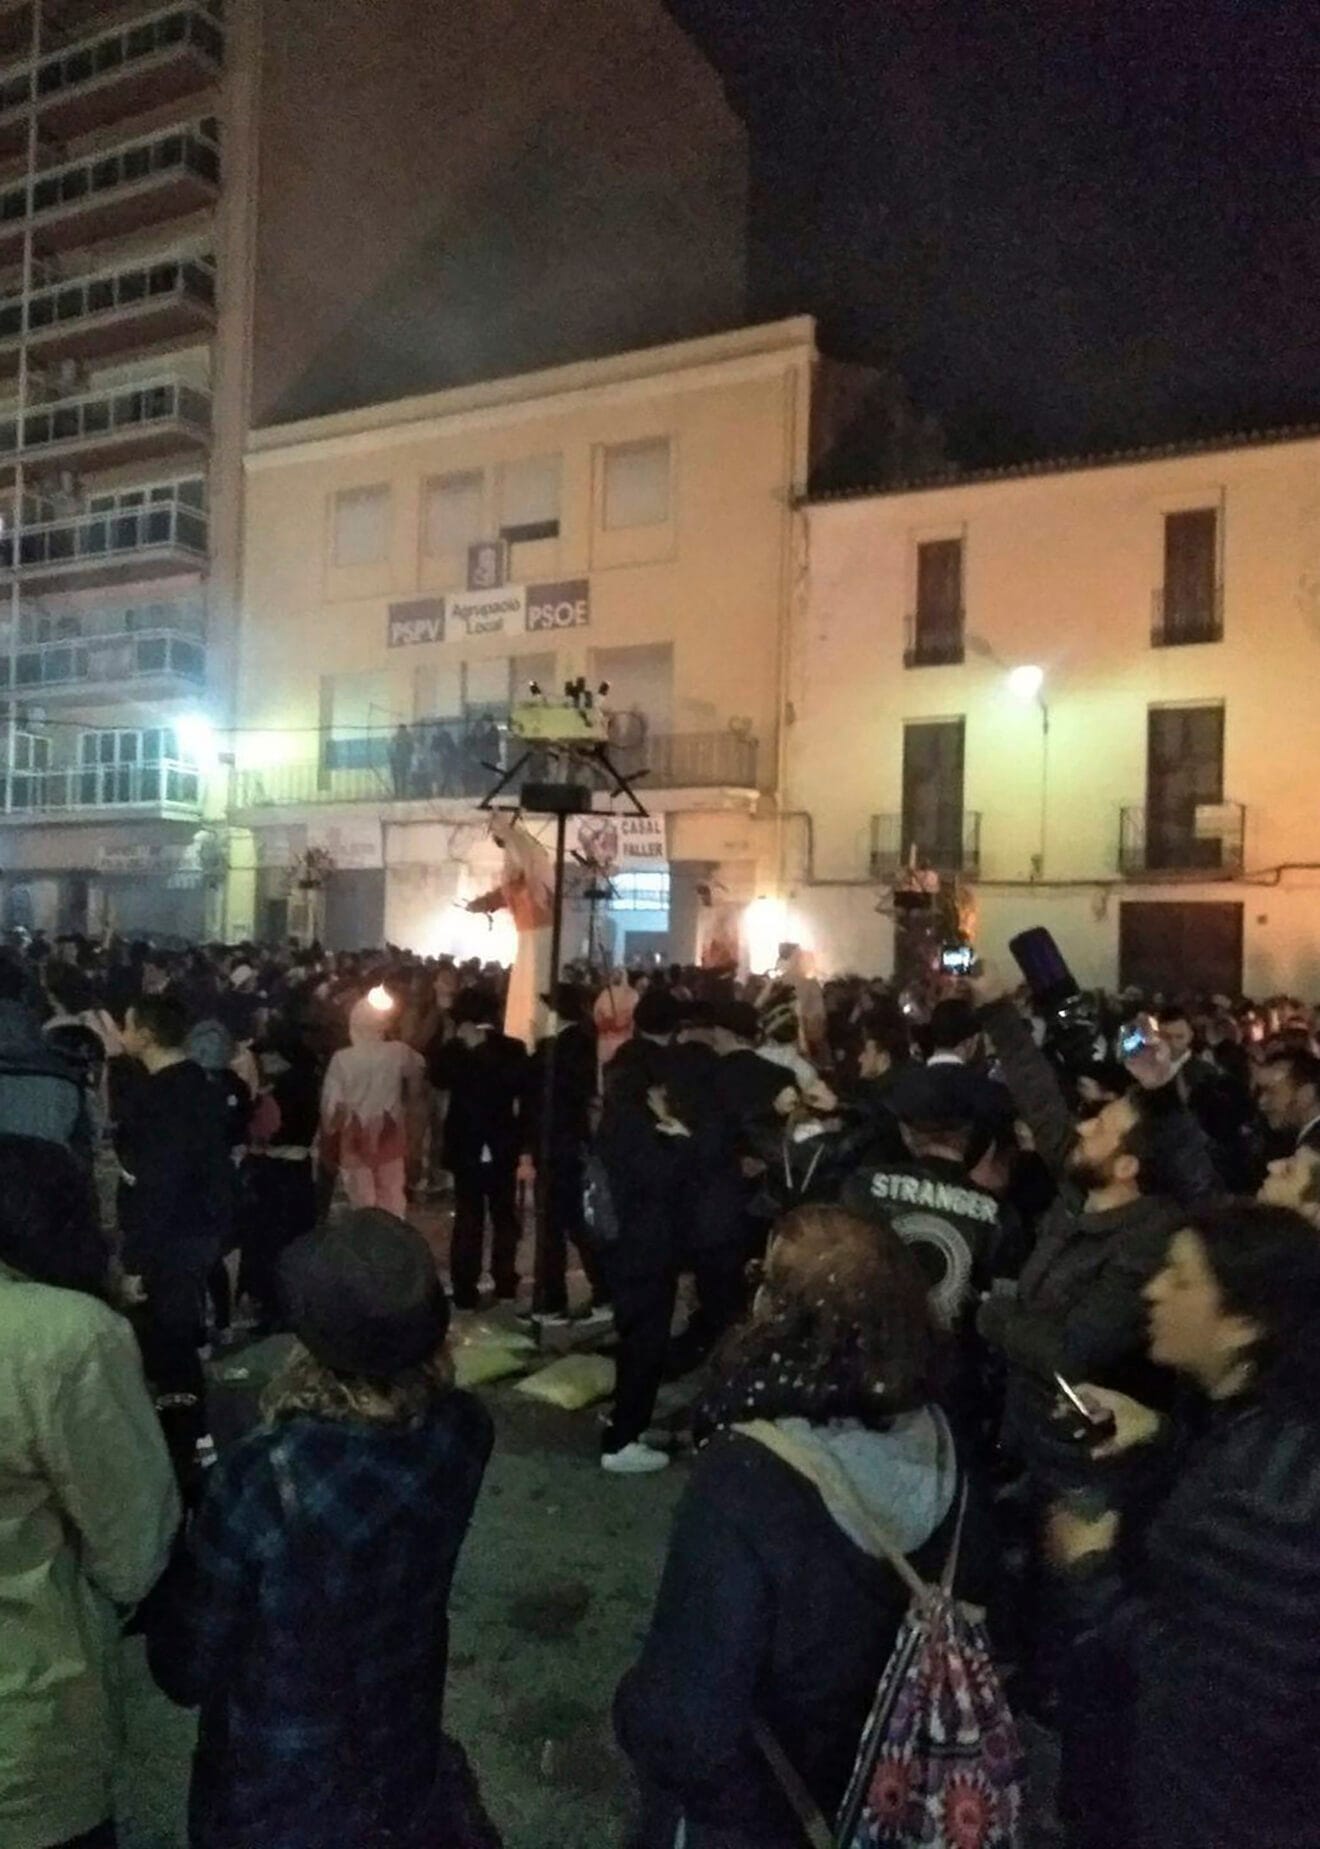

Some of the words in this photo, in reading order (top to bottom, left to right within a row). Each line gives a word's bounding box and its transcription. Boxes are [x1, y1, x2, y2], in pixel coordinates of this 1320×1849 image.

[465, 617, 504, 635] Local
[526, 600, 587, 631] PSOE
[391, 618, 440, 644] PSPV
[622, 820, 660, 834] CASAL
[622, 842, 662, 857] FALLER
[871, 1172, 999, 1225] STRANGER
